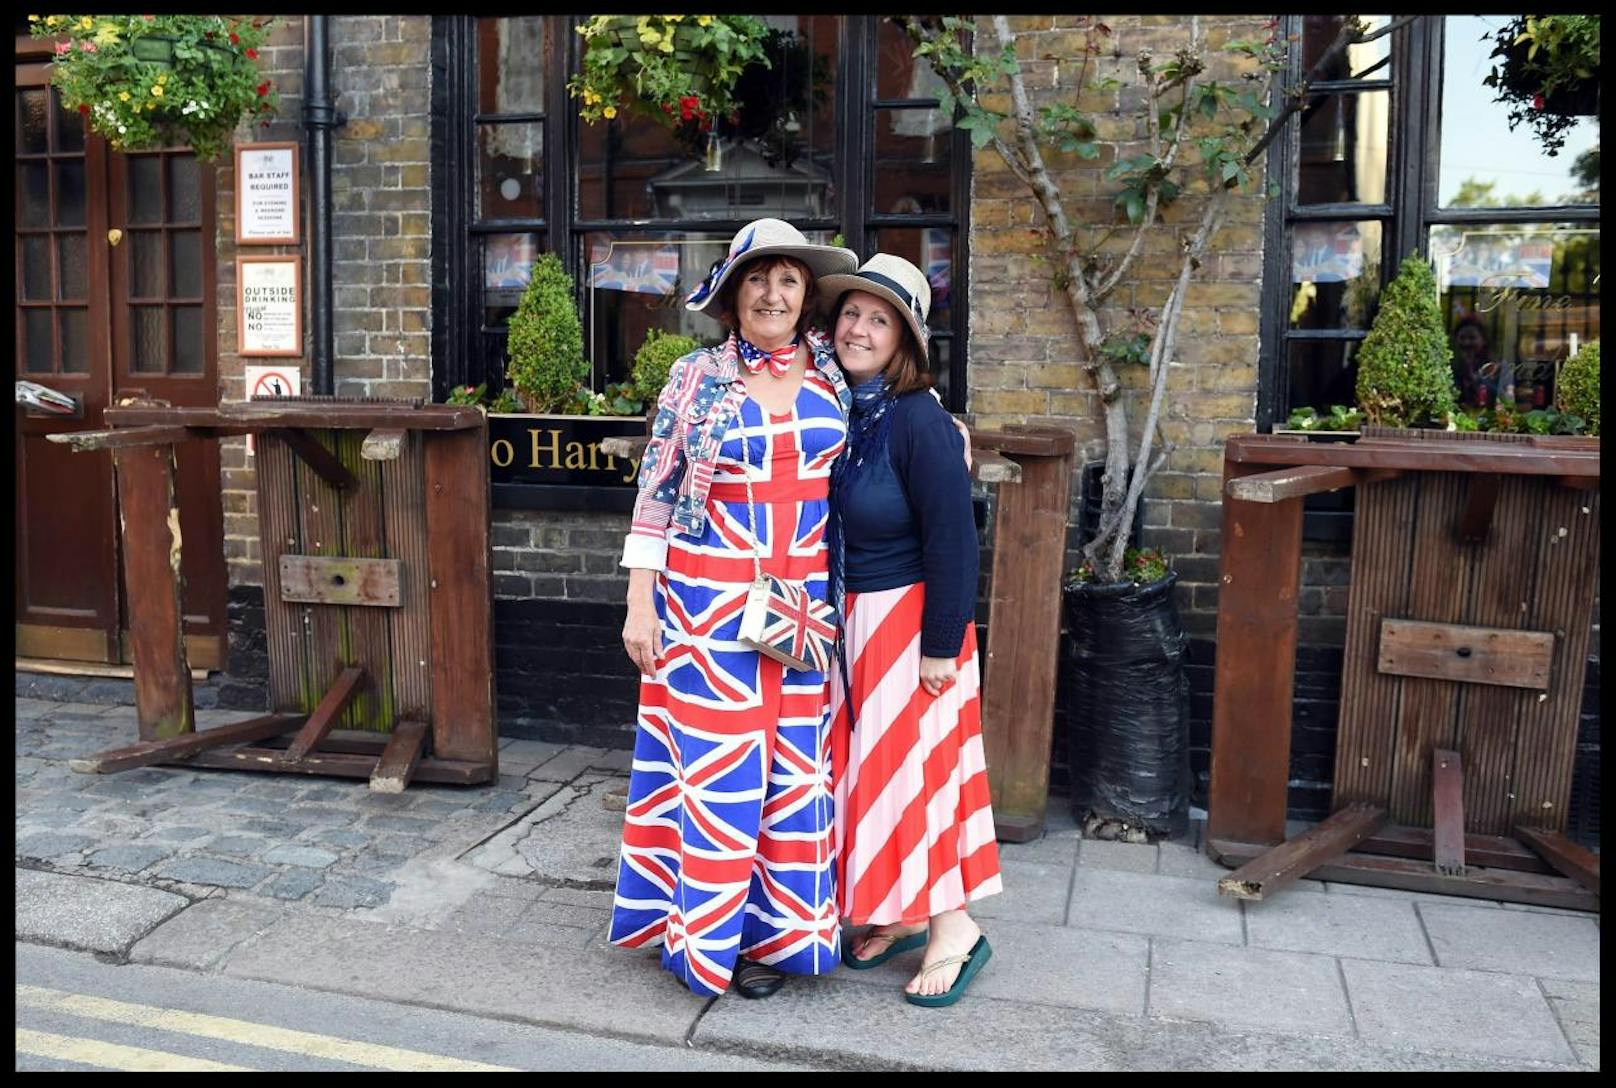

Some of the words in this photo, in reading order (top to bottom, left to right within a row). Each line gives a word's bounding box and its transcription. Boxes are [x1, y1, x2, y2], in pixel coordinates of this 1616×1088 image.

[248, 172, 265, 180] BAR
[267, 172, 290, 180] STAFF
[250, 183, 289, 191] REQUIRED
[245, 287, 295, 295] OUTSIDE
[248, 312, 263, 320] NO
[248, 323, 263, 331] NO
